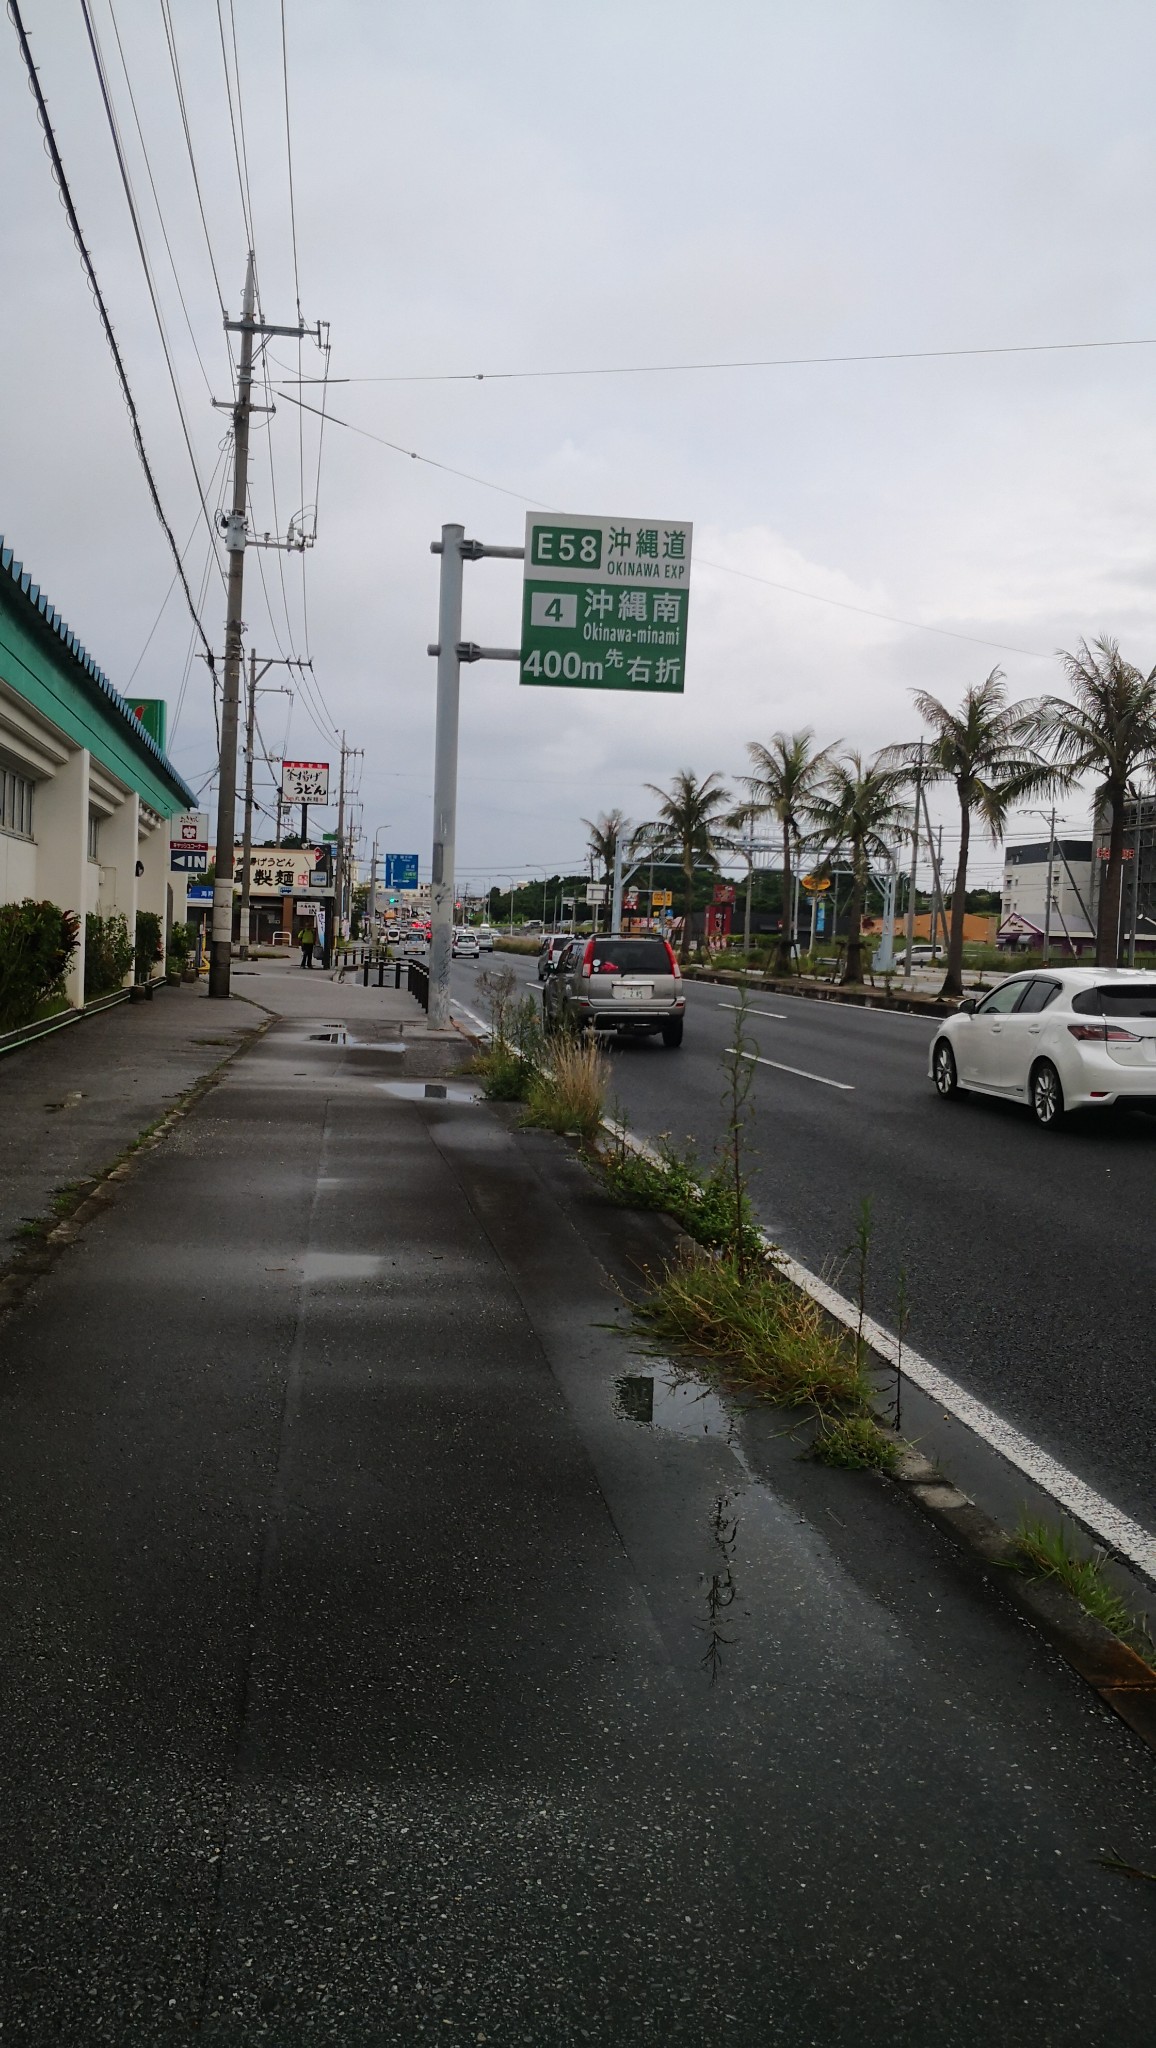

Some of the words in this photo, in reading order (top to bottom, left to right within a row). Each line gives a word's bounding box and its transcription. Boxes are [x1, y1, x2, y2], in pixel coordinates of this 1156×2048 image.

[537, 533, 597, 562] E58
[607, 527, 686, 560] 沖縄道
[607, 561, 660, 578] OKINAWA
[664, 564, 685, 579] EXP
[544, 598, 564, 622] 4
[584, 588, 682, 624] 沖縄南
[583, 622, 680, 645] Okinawa-minami
[293, 782, 327, 796] うどん
[187, 855, 206, 868] IN
